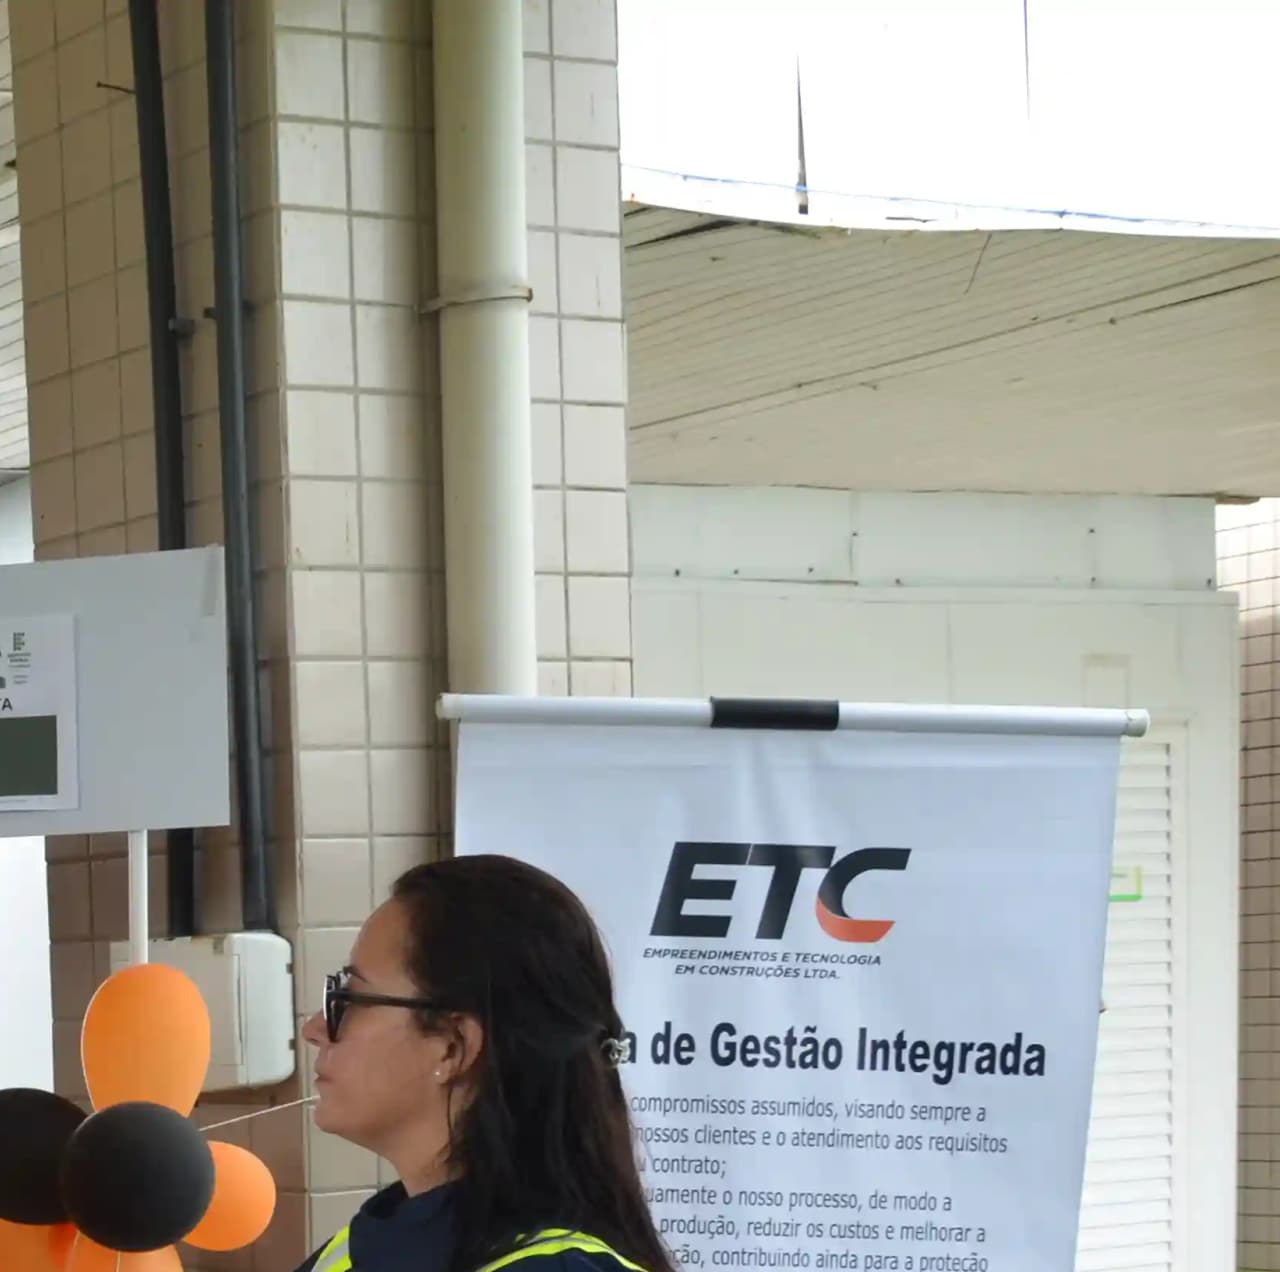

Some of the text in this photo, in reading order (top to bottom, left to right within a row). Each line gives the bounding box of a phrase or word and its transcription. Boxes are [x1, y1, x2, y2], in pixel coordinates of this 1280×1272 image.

[649, 841, 912, 943] ETC
[643, 947, 881, 967] EMPREENDIMENTOS E TECNOLOGIA
[675, 964, 840, 981] EM CONSTRUÇÕES LTDA.
[651, 1021, 696, 1065] de
[710, 1023, 841, 1072] Gestão
[857, 1026, 1046, 1085] Integrada
[631, 1094, 985, 1126] compromissos assumidos, visando sempre a
[695, 1125, 756, 1145] clientes
[762, 1132, 771, 1146] e
[776, 1131, 786, 1147] o
[791, 1129, 889, 1151] atendimento
[894, 1134, 922, 1152] aos
[929, 1132, 1007, 1159] requisitos
[652, 1156, 726, 1178] contrato;
[646, 1186, 952, 1215] uamente o nosso processo, de modo a
[660, 1215, 985, 1243] produção, reduzir os custos e melhorar a
[712, 1248, 810, 1267] contribuindo
[816, 1249, 858, 1270] ainda
[905, 1257, 913, 1272] a
